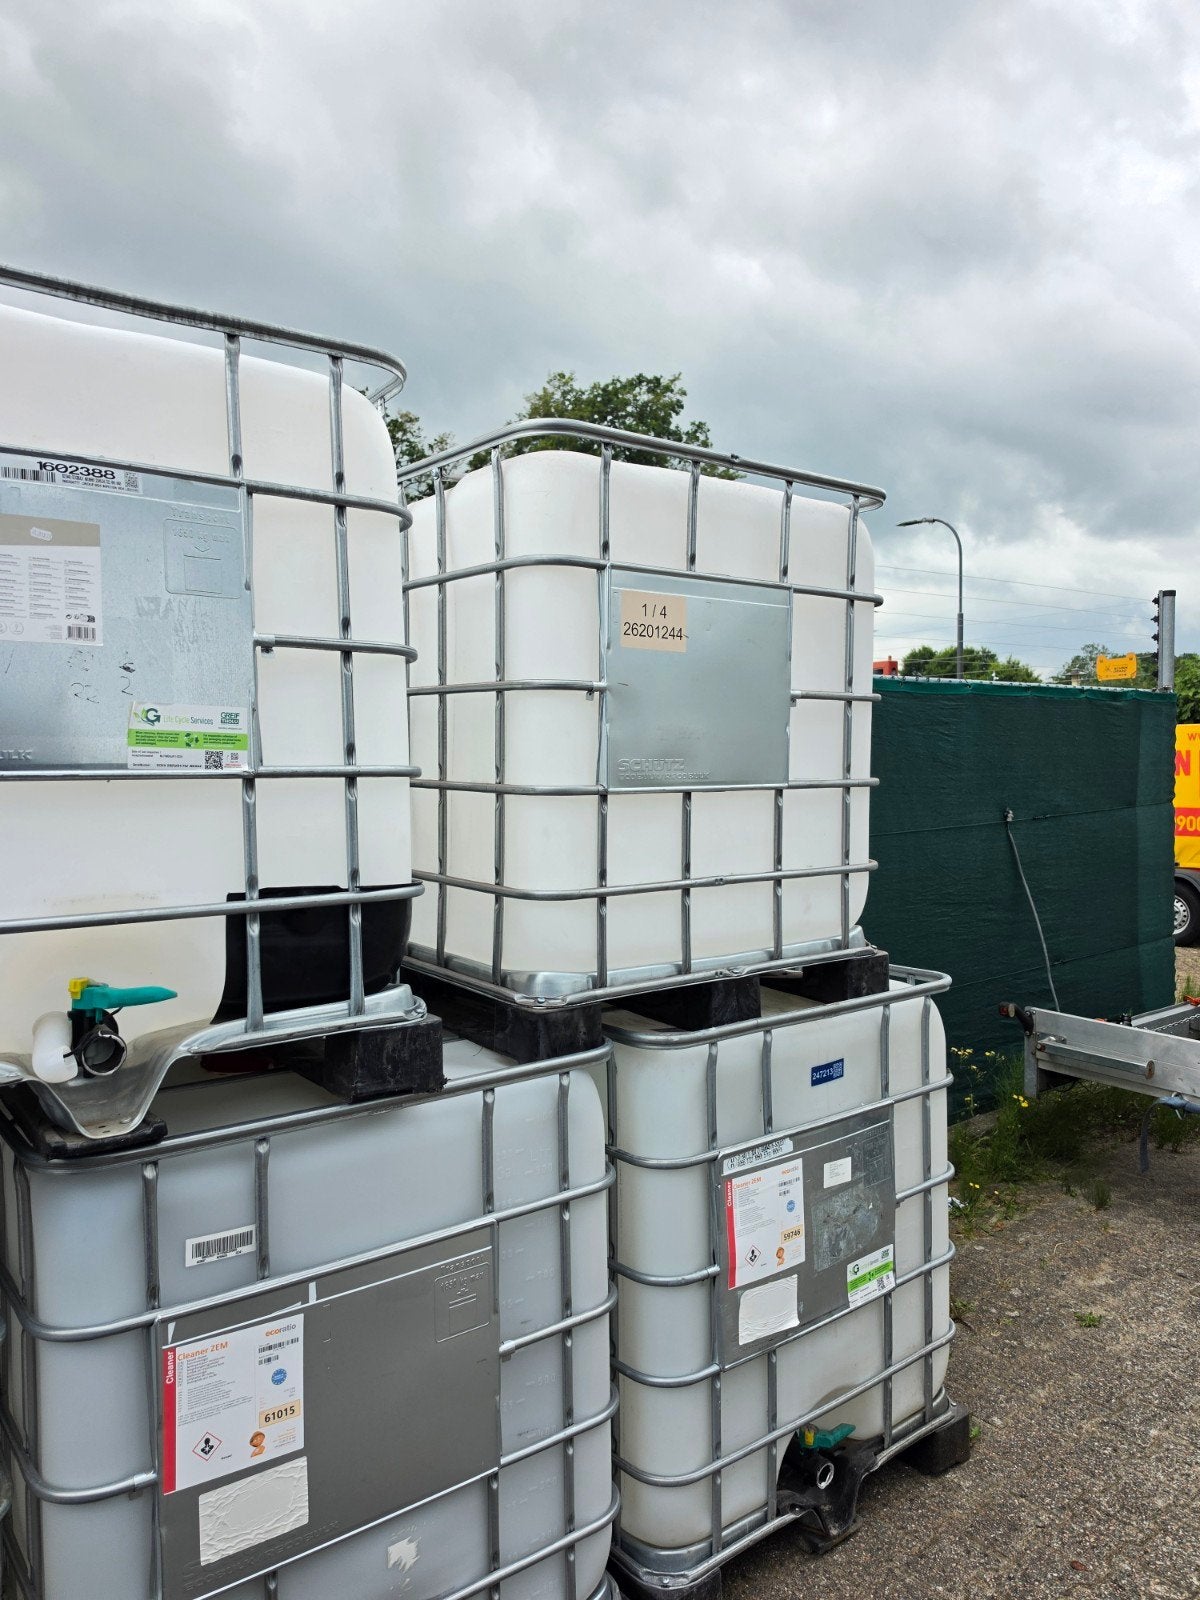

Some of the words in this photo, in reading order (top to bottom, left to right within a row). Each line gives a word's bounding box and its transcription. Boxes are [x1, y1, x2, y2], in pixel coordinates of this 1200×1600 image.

[37, 461, 116, 480] 1602388
[642, 603, 647, 617] 1
[659, 605, 667, 619] 4
[623, 621, 684, 641] 26201244
[190, 716, 214, 726] Services
[812, 1067, 834, 1080] 247213
[265, 1323, 297, 1337] ecoratio
[177, 1347, 209, 1362] Cleaner
[210, 1341, 229, 1353] ZEM
[165, 1351, 175, 1385] Cleaner
[264, 1405, 295, 1423] 61015
